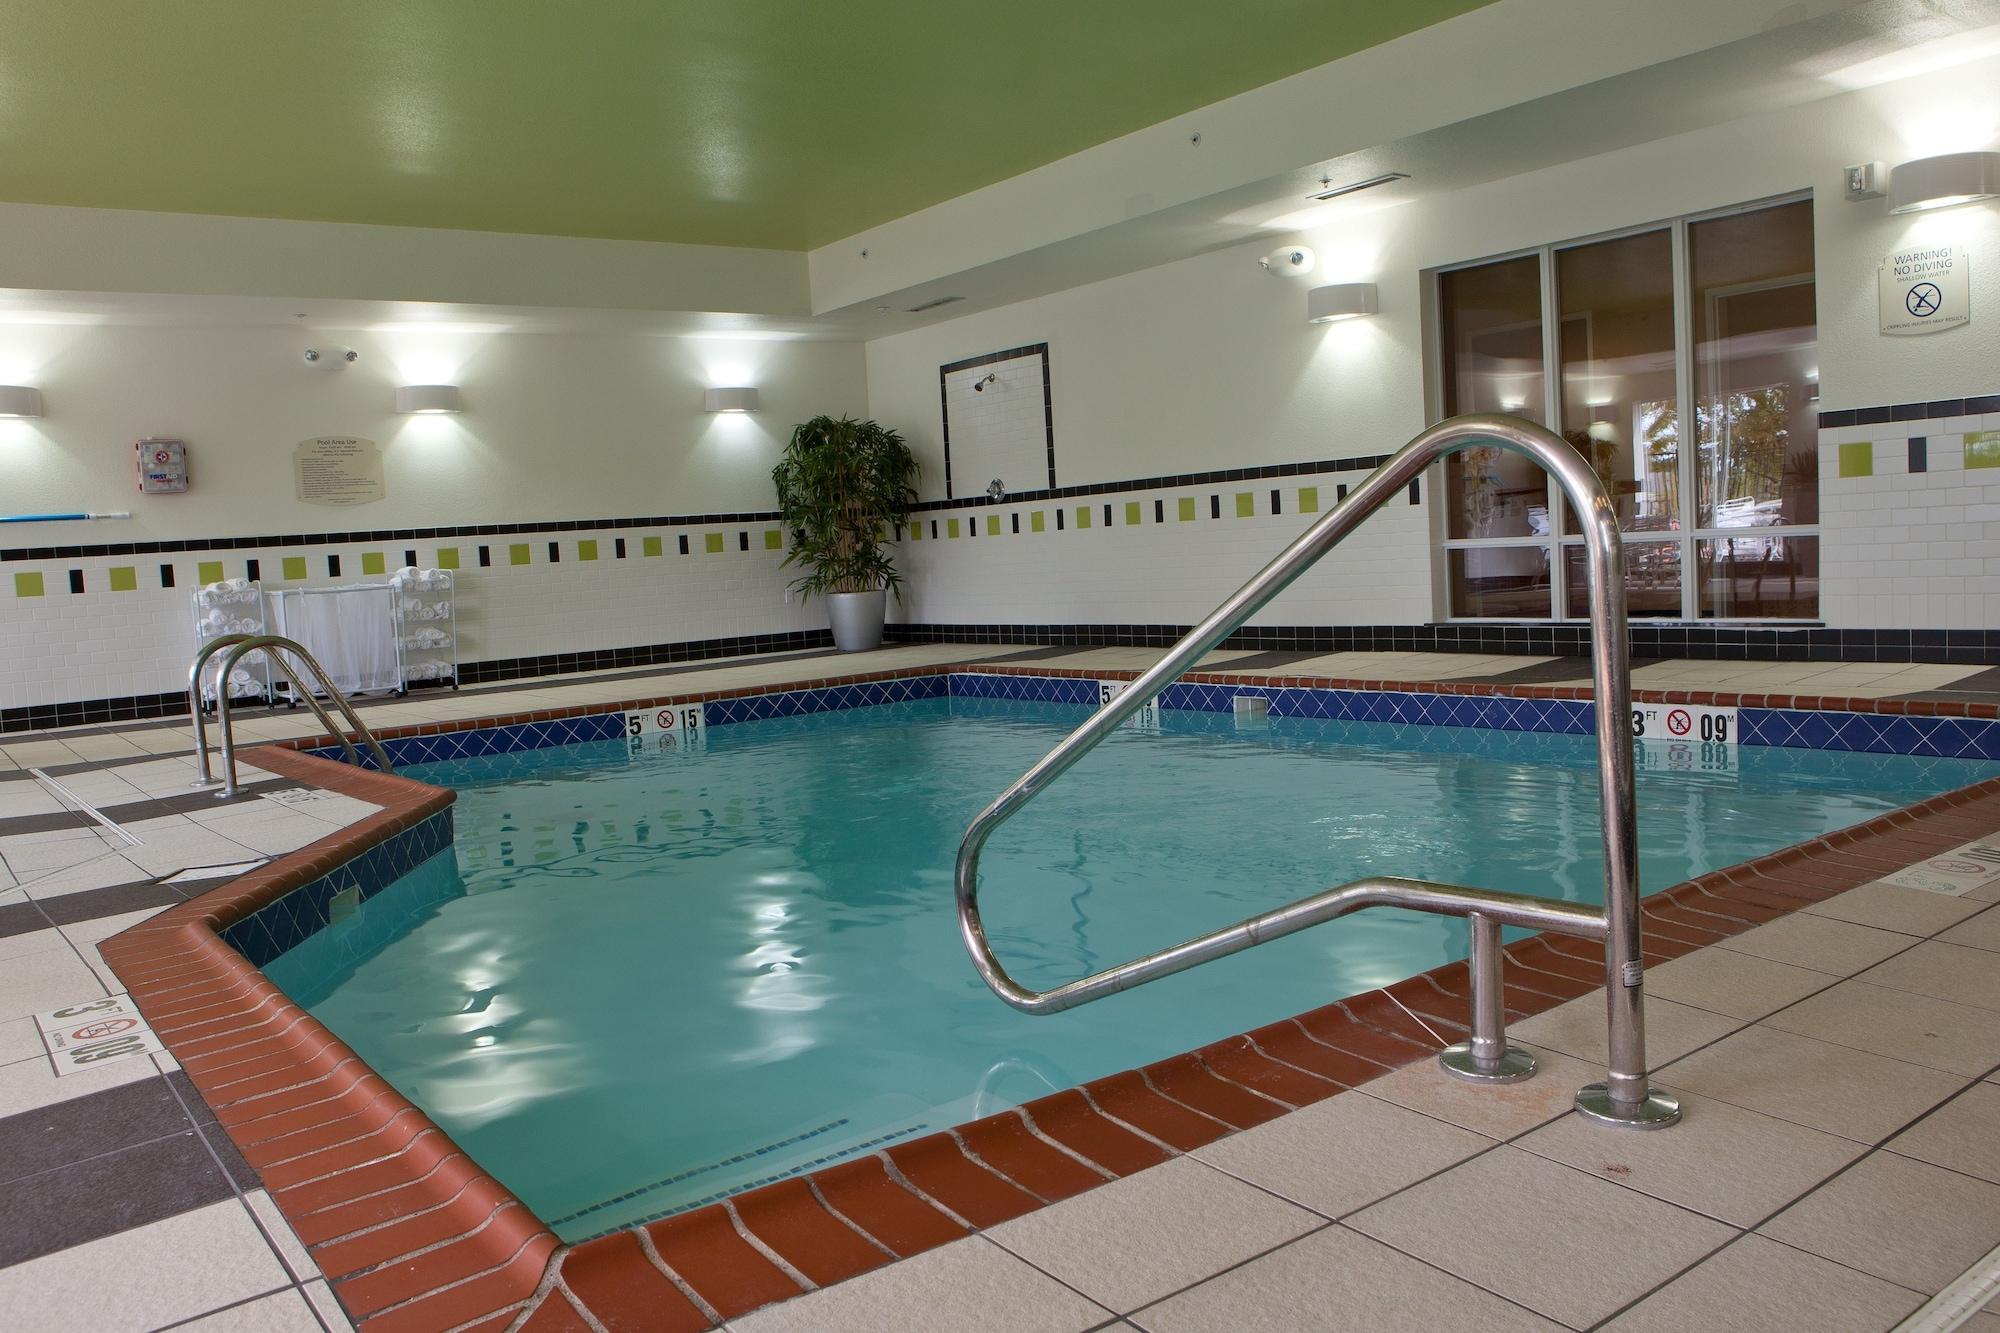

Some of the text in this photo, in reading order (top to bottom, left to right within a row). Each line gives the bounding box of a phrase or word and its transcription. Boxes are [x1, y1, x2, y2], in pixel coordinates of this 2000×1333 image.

[1895, 248, 1952, 265] WARNING!
[1894, 259, 1953, 276] NO DIVING
[1897, 270, 1950, 282] SHALLOW WATER
[1101, 685, 1110, 704] 5
[629, 715, 642, 735] 5
[1632, 710, 1645, 736] 3
[1646, 711, 1657, 720] FT
